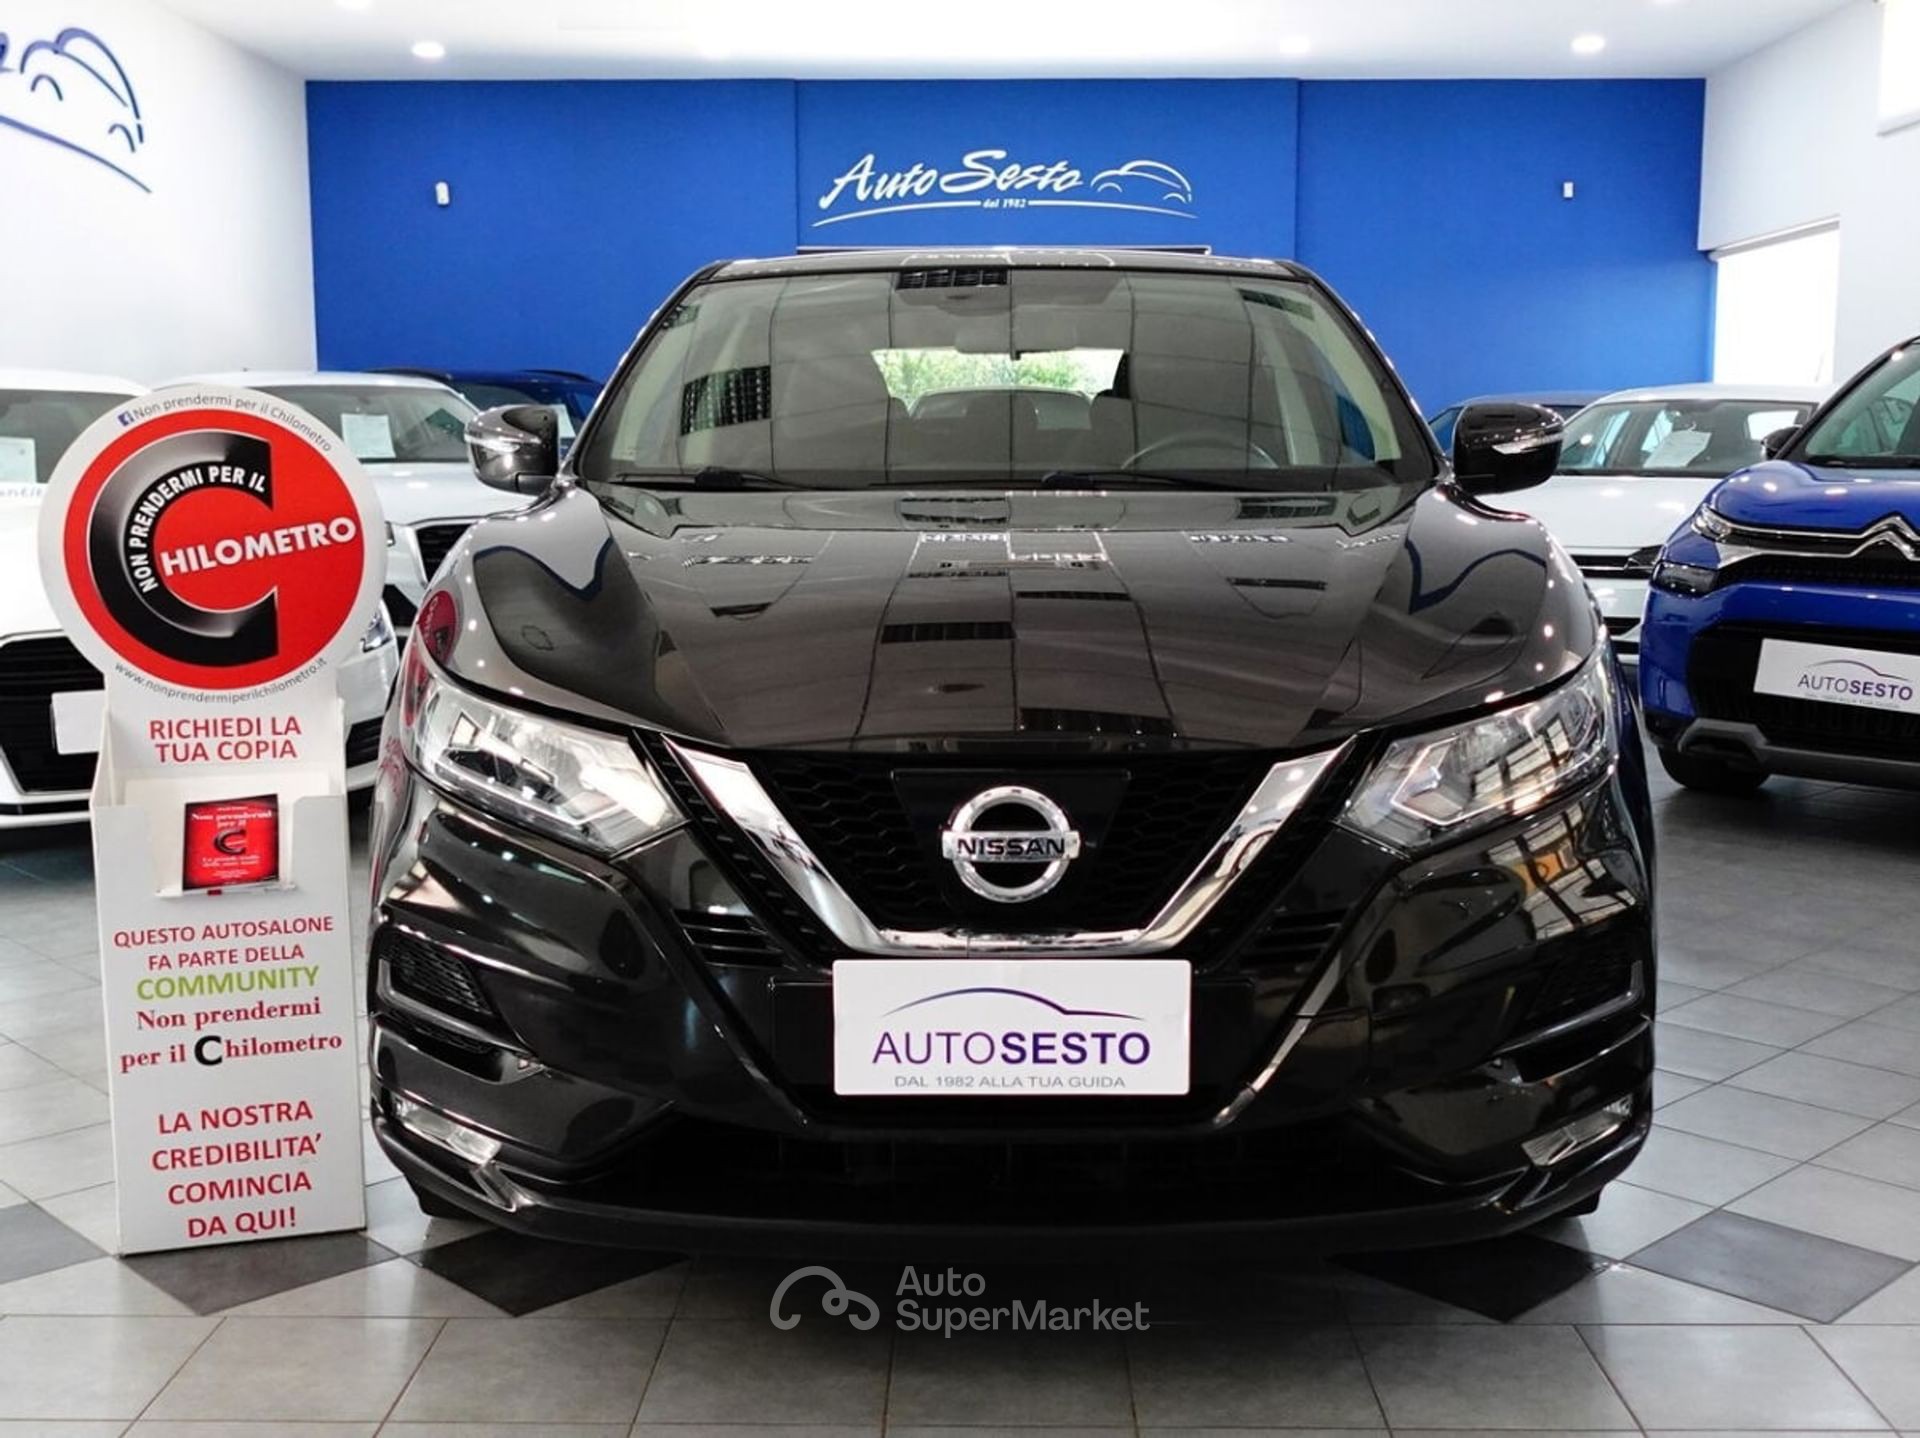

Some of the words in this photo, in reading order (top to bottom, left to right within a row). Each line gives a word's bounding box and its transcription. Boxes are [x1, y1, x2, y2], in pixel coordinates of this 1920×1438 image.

[818, 153, 938, 209] Auto
[938, 148, 1083, 194] Sesto
[133, 405, 160, 420] Non
[164, 394, 231, 411] prendermi
[235, 399, 257, 411] per
[260, 398, 269, 413] il
[270, 407, 332, 452] Chilometro
[208, 466, 246, 485] PER
[248, 472, 266, 492] IL
[129, 467, 204, 548] PRENDERMI
[130, 553, 159, 593] NON
[115, 657, 327, 704] www.nonprendermiperilchilometro.it
[1797, 674, 1913, 701] AUTOSESTO
[150, 717, 262, 740] RICHIEDI
[271, 716, 302, 736] LA
[155, 742, 210, 763] TUA
[217, 739, 297, 761] COPIA
[957, 839, 1066, 857] NISSAN
[114, 926, 195, 947] QUESTO
[202, 916, 333, 941] AUTOSALONE
[148, 955, 171, 971] FA
[178, 949, 238, 969] PARTE
[245, 944, 304, 963] DELLA
[136, 965, 319, 1000] COMMUNITY
[136, 1010, 185, 1031] Non
[194, 997, 321, 1031] prendermi
[120, 1052, 161, 1073] per
[169, 1044, 186, 1063] il
[193, 1033, 343, 1067] Chilometro
[872, 1031, 1151, 1065] AUTOSESTO
[894, 1076, 928, 1088] DAL
[935, 1076, 974, 1088] 1982
[978, 1076, 1023, 1088] ALLA
[1027, 1076, 1063, 1088] TUA
[1067, 1076, 1126, 1088] GUIDA
[158, 1112, 192, 1135] LA
[200, 1100, 314, 1130] NOSTRA
[167, 1171, 312, 1205] COMINCIA
[188, 1215, 227, 1239] DA
[234, 1206, 296, 1235] QUI!
